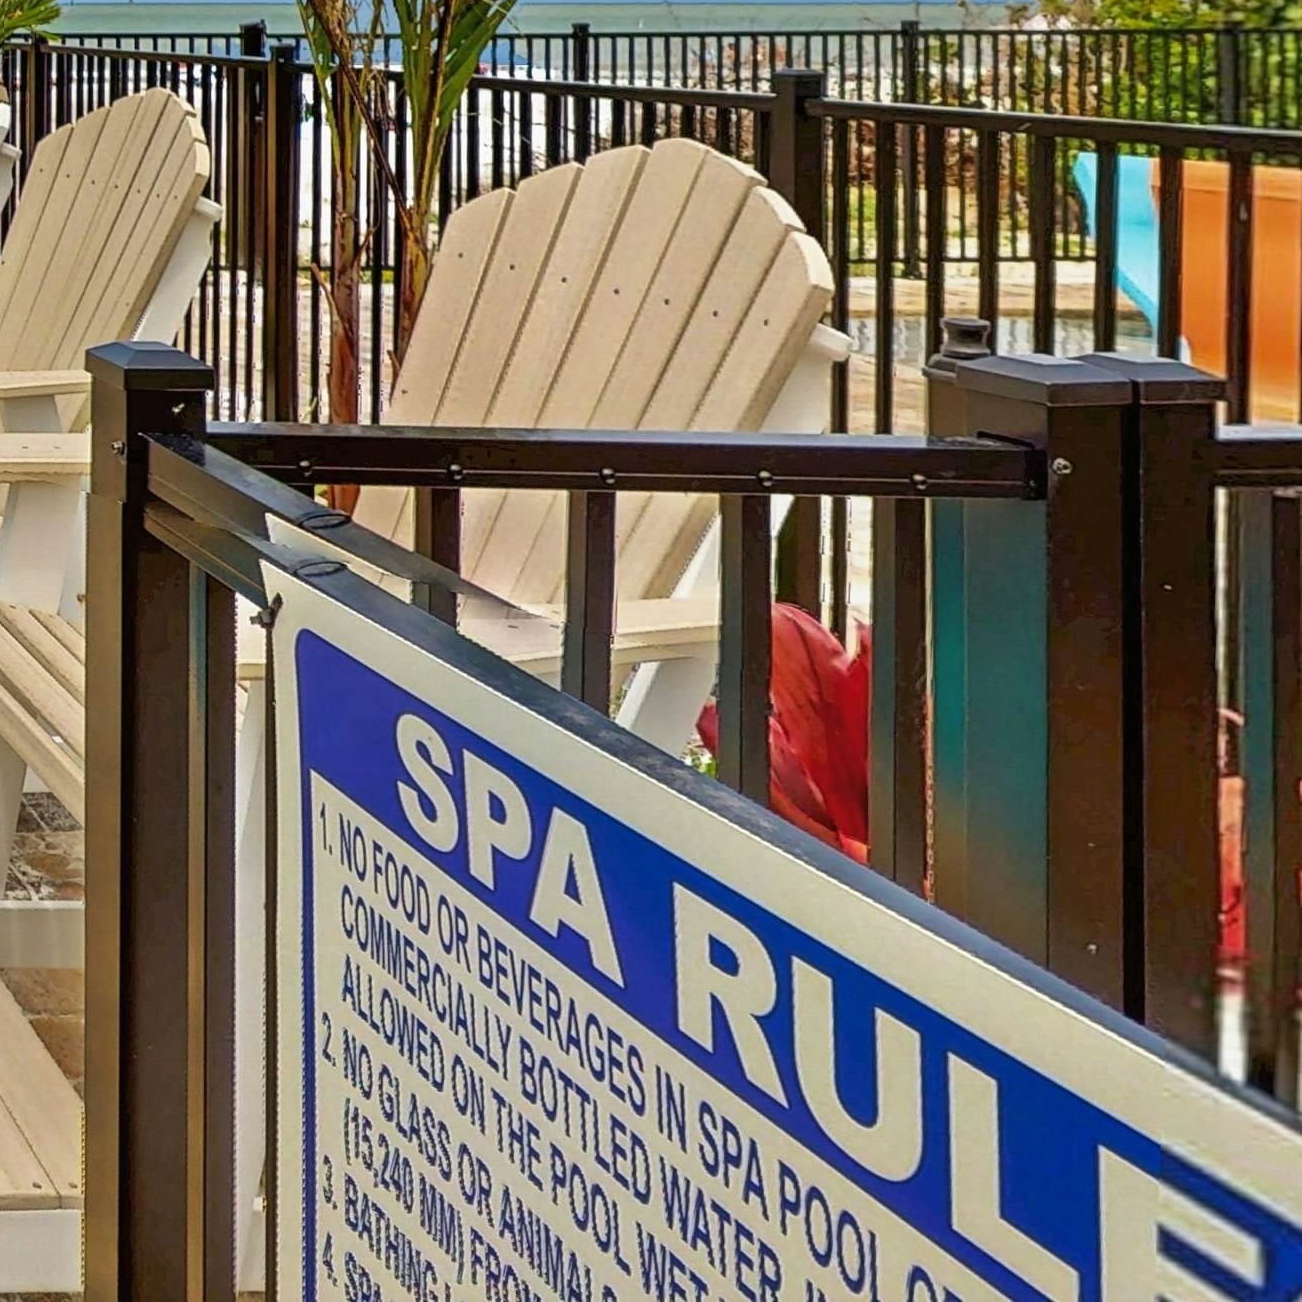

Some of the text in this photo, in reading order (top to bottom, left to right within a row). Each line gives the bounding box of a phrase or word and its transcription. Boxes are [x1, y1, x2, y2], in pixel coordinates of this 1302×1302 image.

[396, 713, 625, 989] SPA
[319, 802, 333, 856] 1.
[339, 811, 367, 882] NO
[372, 839, 431, 935] FOOD
[437, 894, 472, 974] OR
[477, 923, 645, 1117] BEVERAGES
[655, 1064, 688, 1155] IN
[698, 1100, 770, 1222] SPA
[322, 1011, 337, 1068] 2.
[342, 1026, 373, 1100] NO
[378, 1063, 452, 1182] GLASS
[457, 1142, 495, 1229] OR
[340, 883, 783, 1302] COMMERCIALLY BOTTLED WATER
[341, 953, 445, 1093] ALLOWED
[451, 1054, 487, 1135] ON
[491, 1087, 544, 1192] THE
[550, 1141, 632, 1277] POOL
[344, 1097, 415, 1214] (15,240
